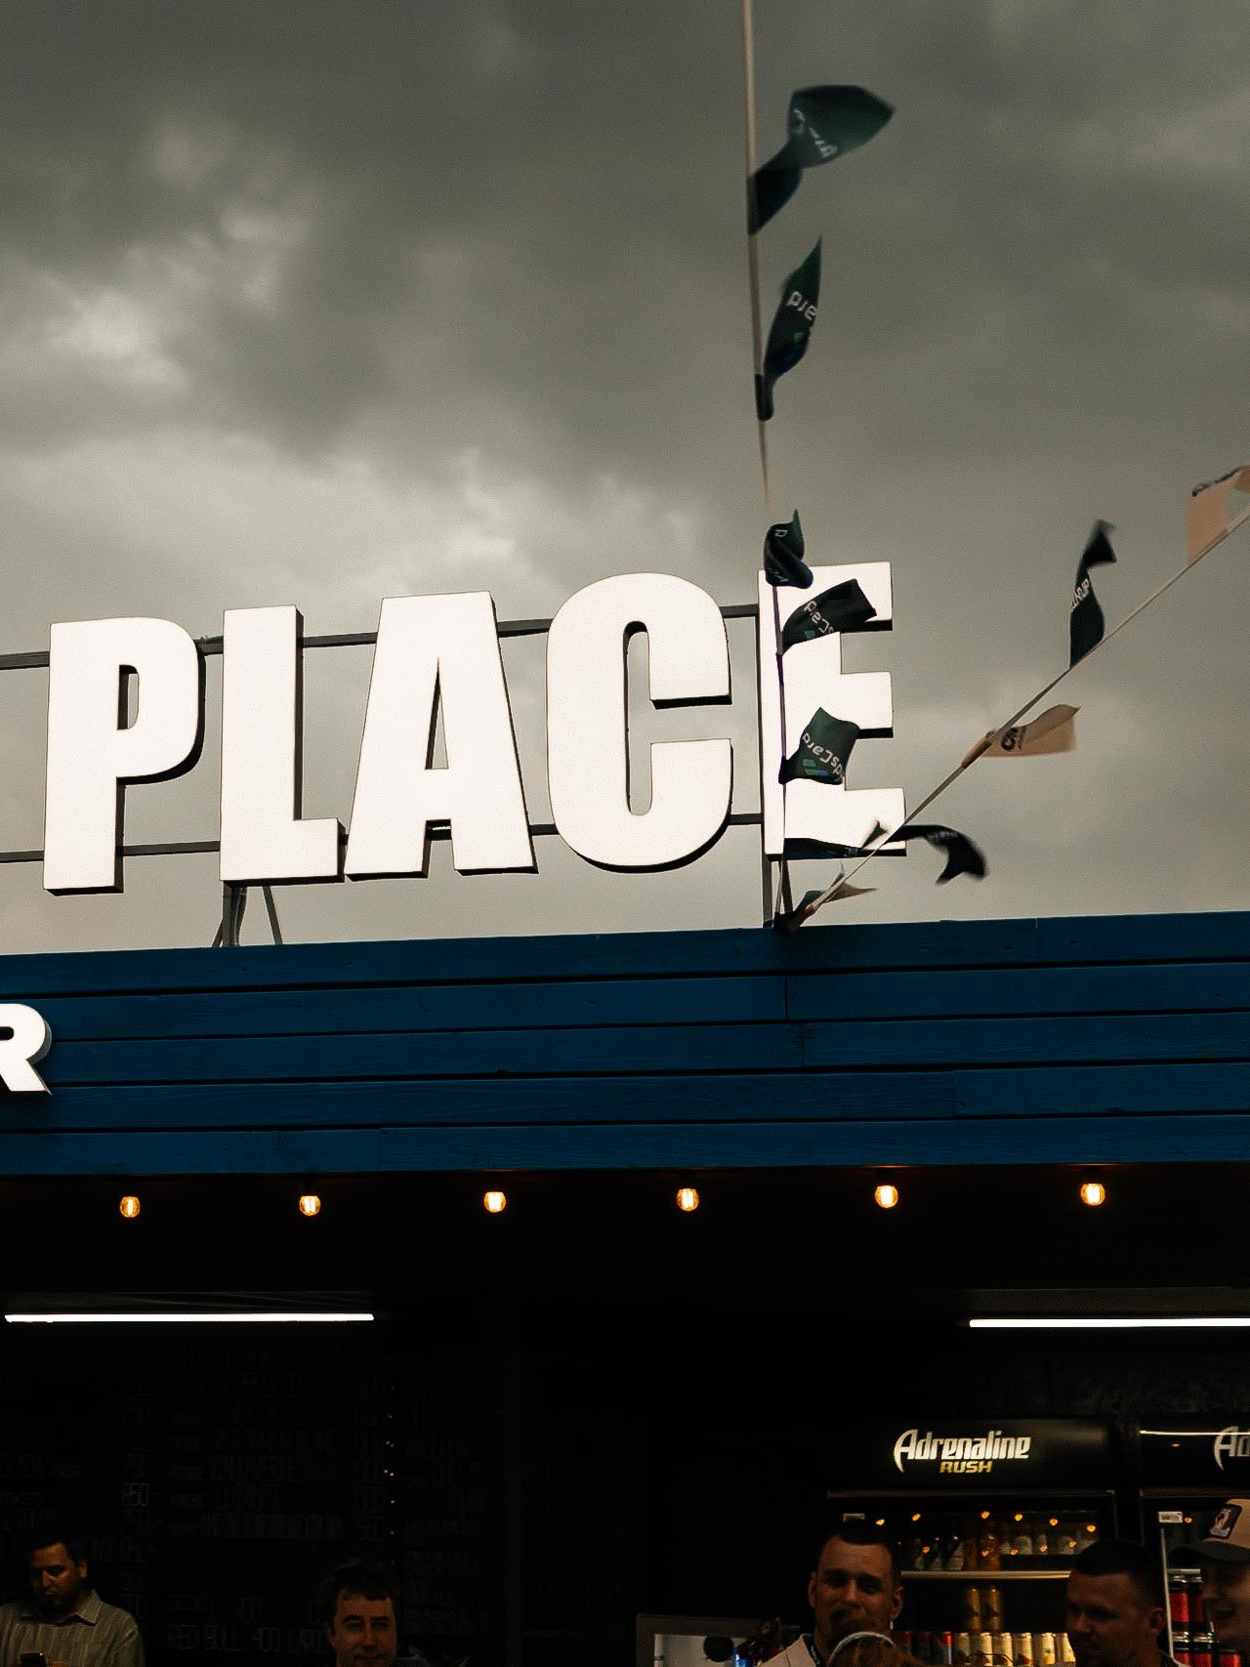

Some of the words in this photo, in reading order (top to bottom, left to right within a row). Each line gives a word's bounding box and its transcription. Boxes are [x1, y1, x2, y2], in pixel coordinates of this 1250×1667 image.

[43, 561, 907, 893] PLACE
[893, 1428, 1031, 1473] Adrenaline
[939, 1460, 993, 1474] RUSH
